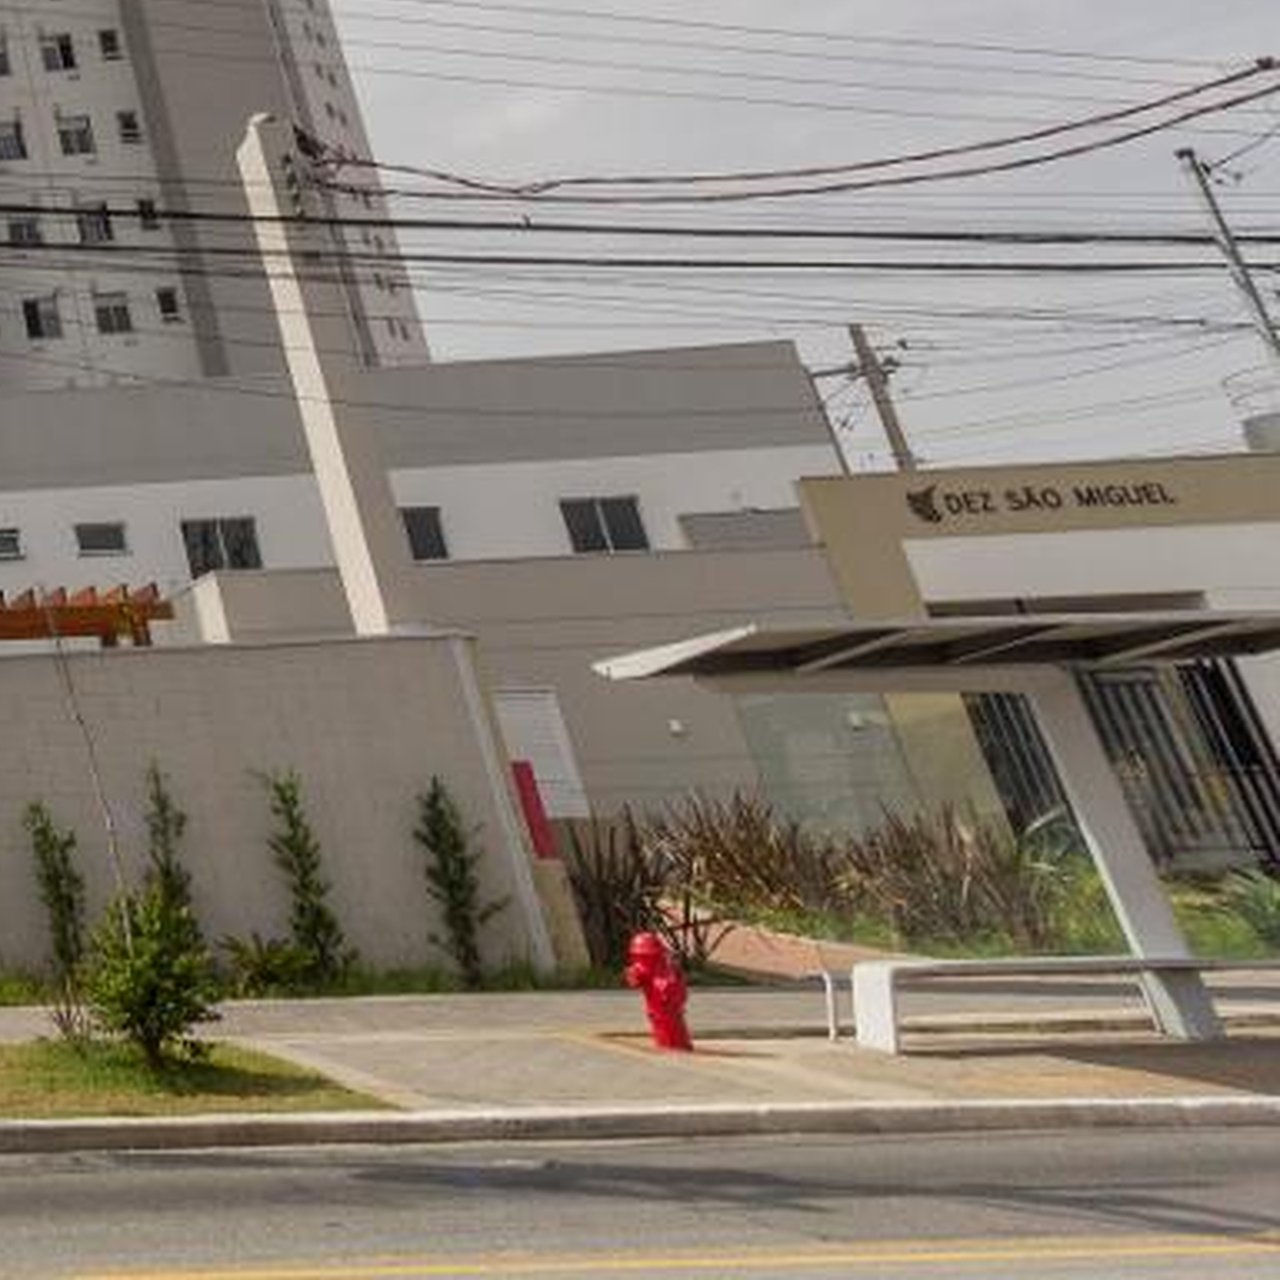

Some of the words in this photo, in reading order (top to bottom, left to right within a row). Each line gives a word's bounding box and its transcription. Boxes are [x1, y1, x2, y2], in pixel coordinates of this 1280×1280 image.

[944, 491, 996, 515] DEZ
[1005, 483, 1063, 512] SÃO
[1072, 482, 1177, 507] MIGUEL
